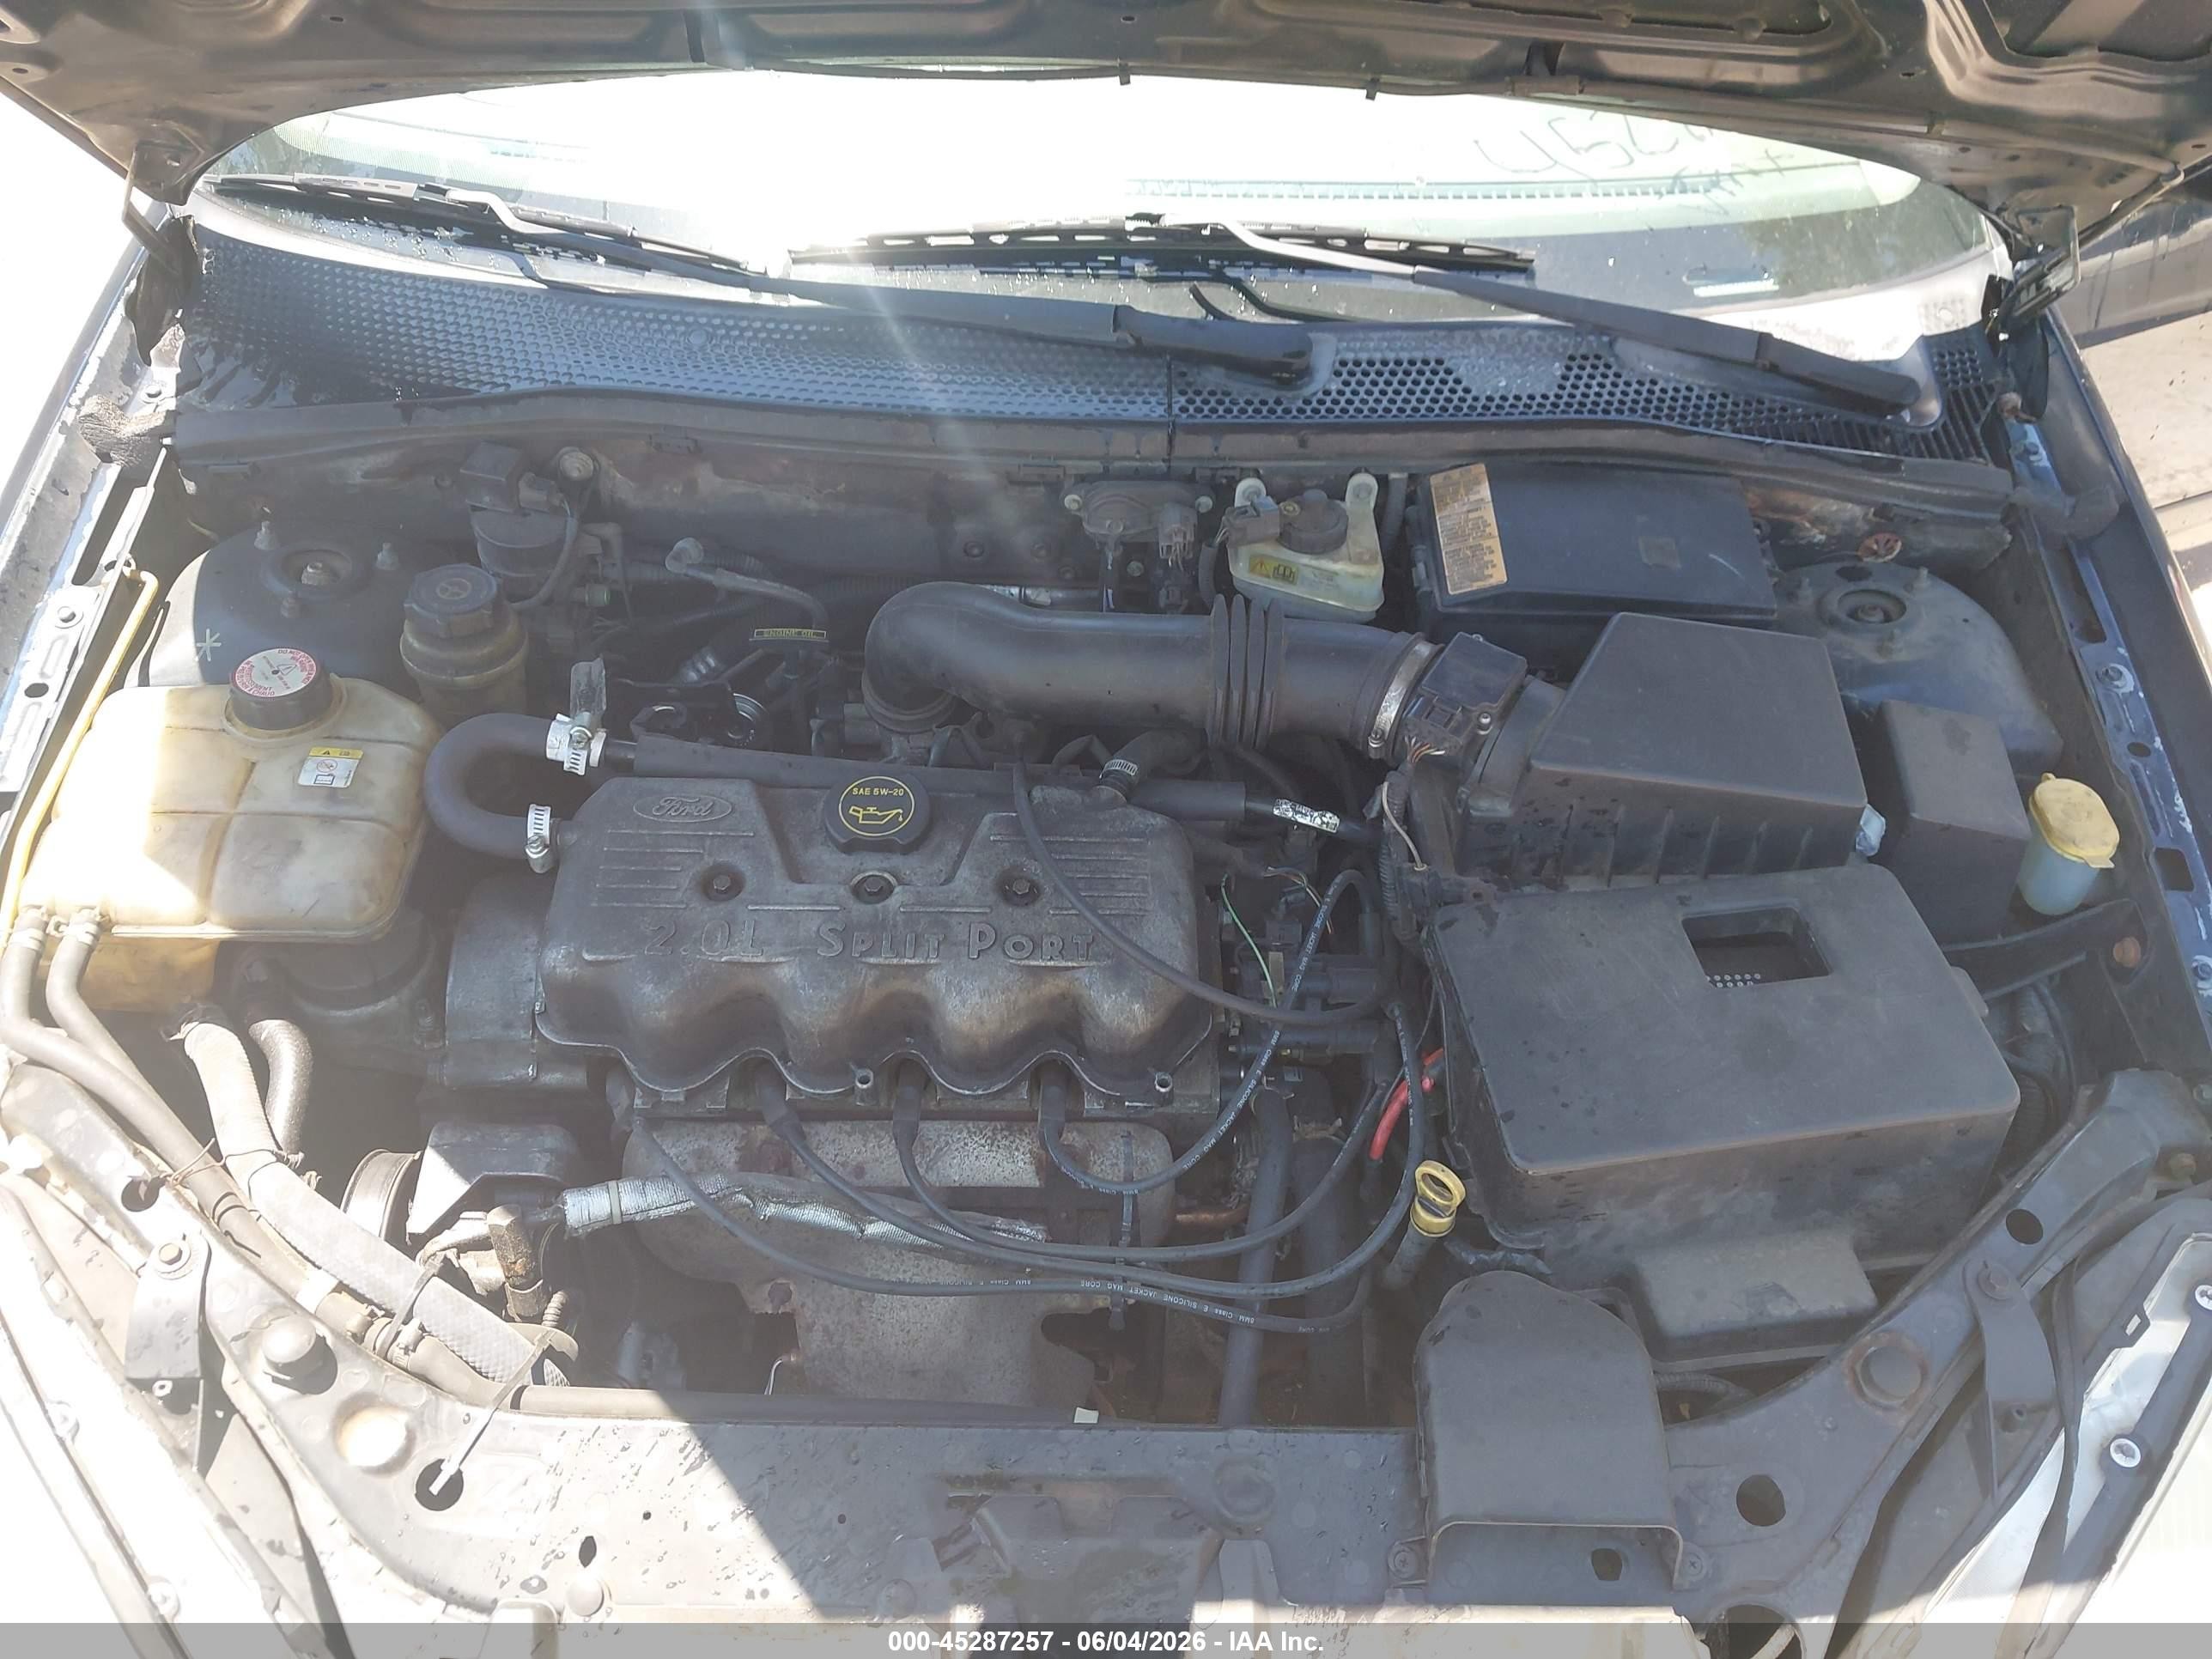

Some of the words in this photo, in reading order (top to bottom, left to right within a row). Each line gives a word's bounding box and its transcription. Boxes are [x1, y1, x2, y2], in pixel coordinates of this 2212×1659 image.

[852, 787, 871, 796] SAE
[873, 787, 904, 797] 5W-20
[653, 796, 714, 816] Ford
[645, 920, 763, 956] 2.0L
[1107, 1282, 1123, 1291] MAG
[1129, 1286, 1158, 1298] JACKET
[1163, 1294, 1198, 1309] SILICONE
[1214, 1308, 1234, 1320] Class
